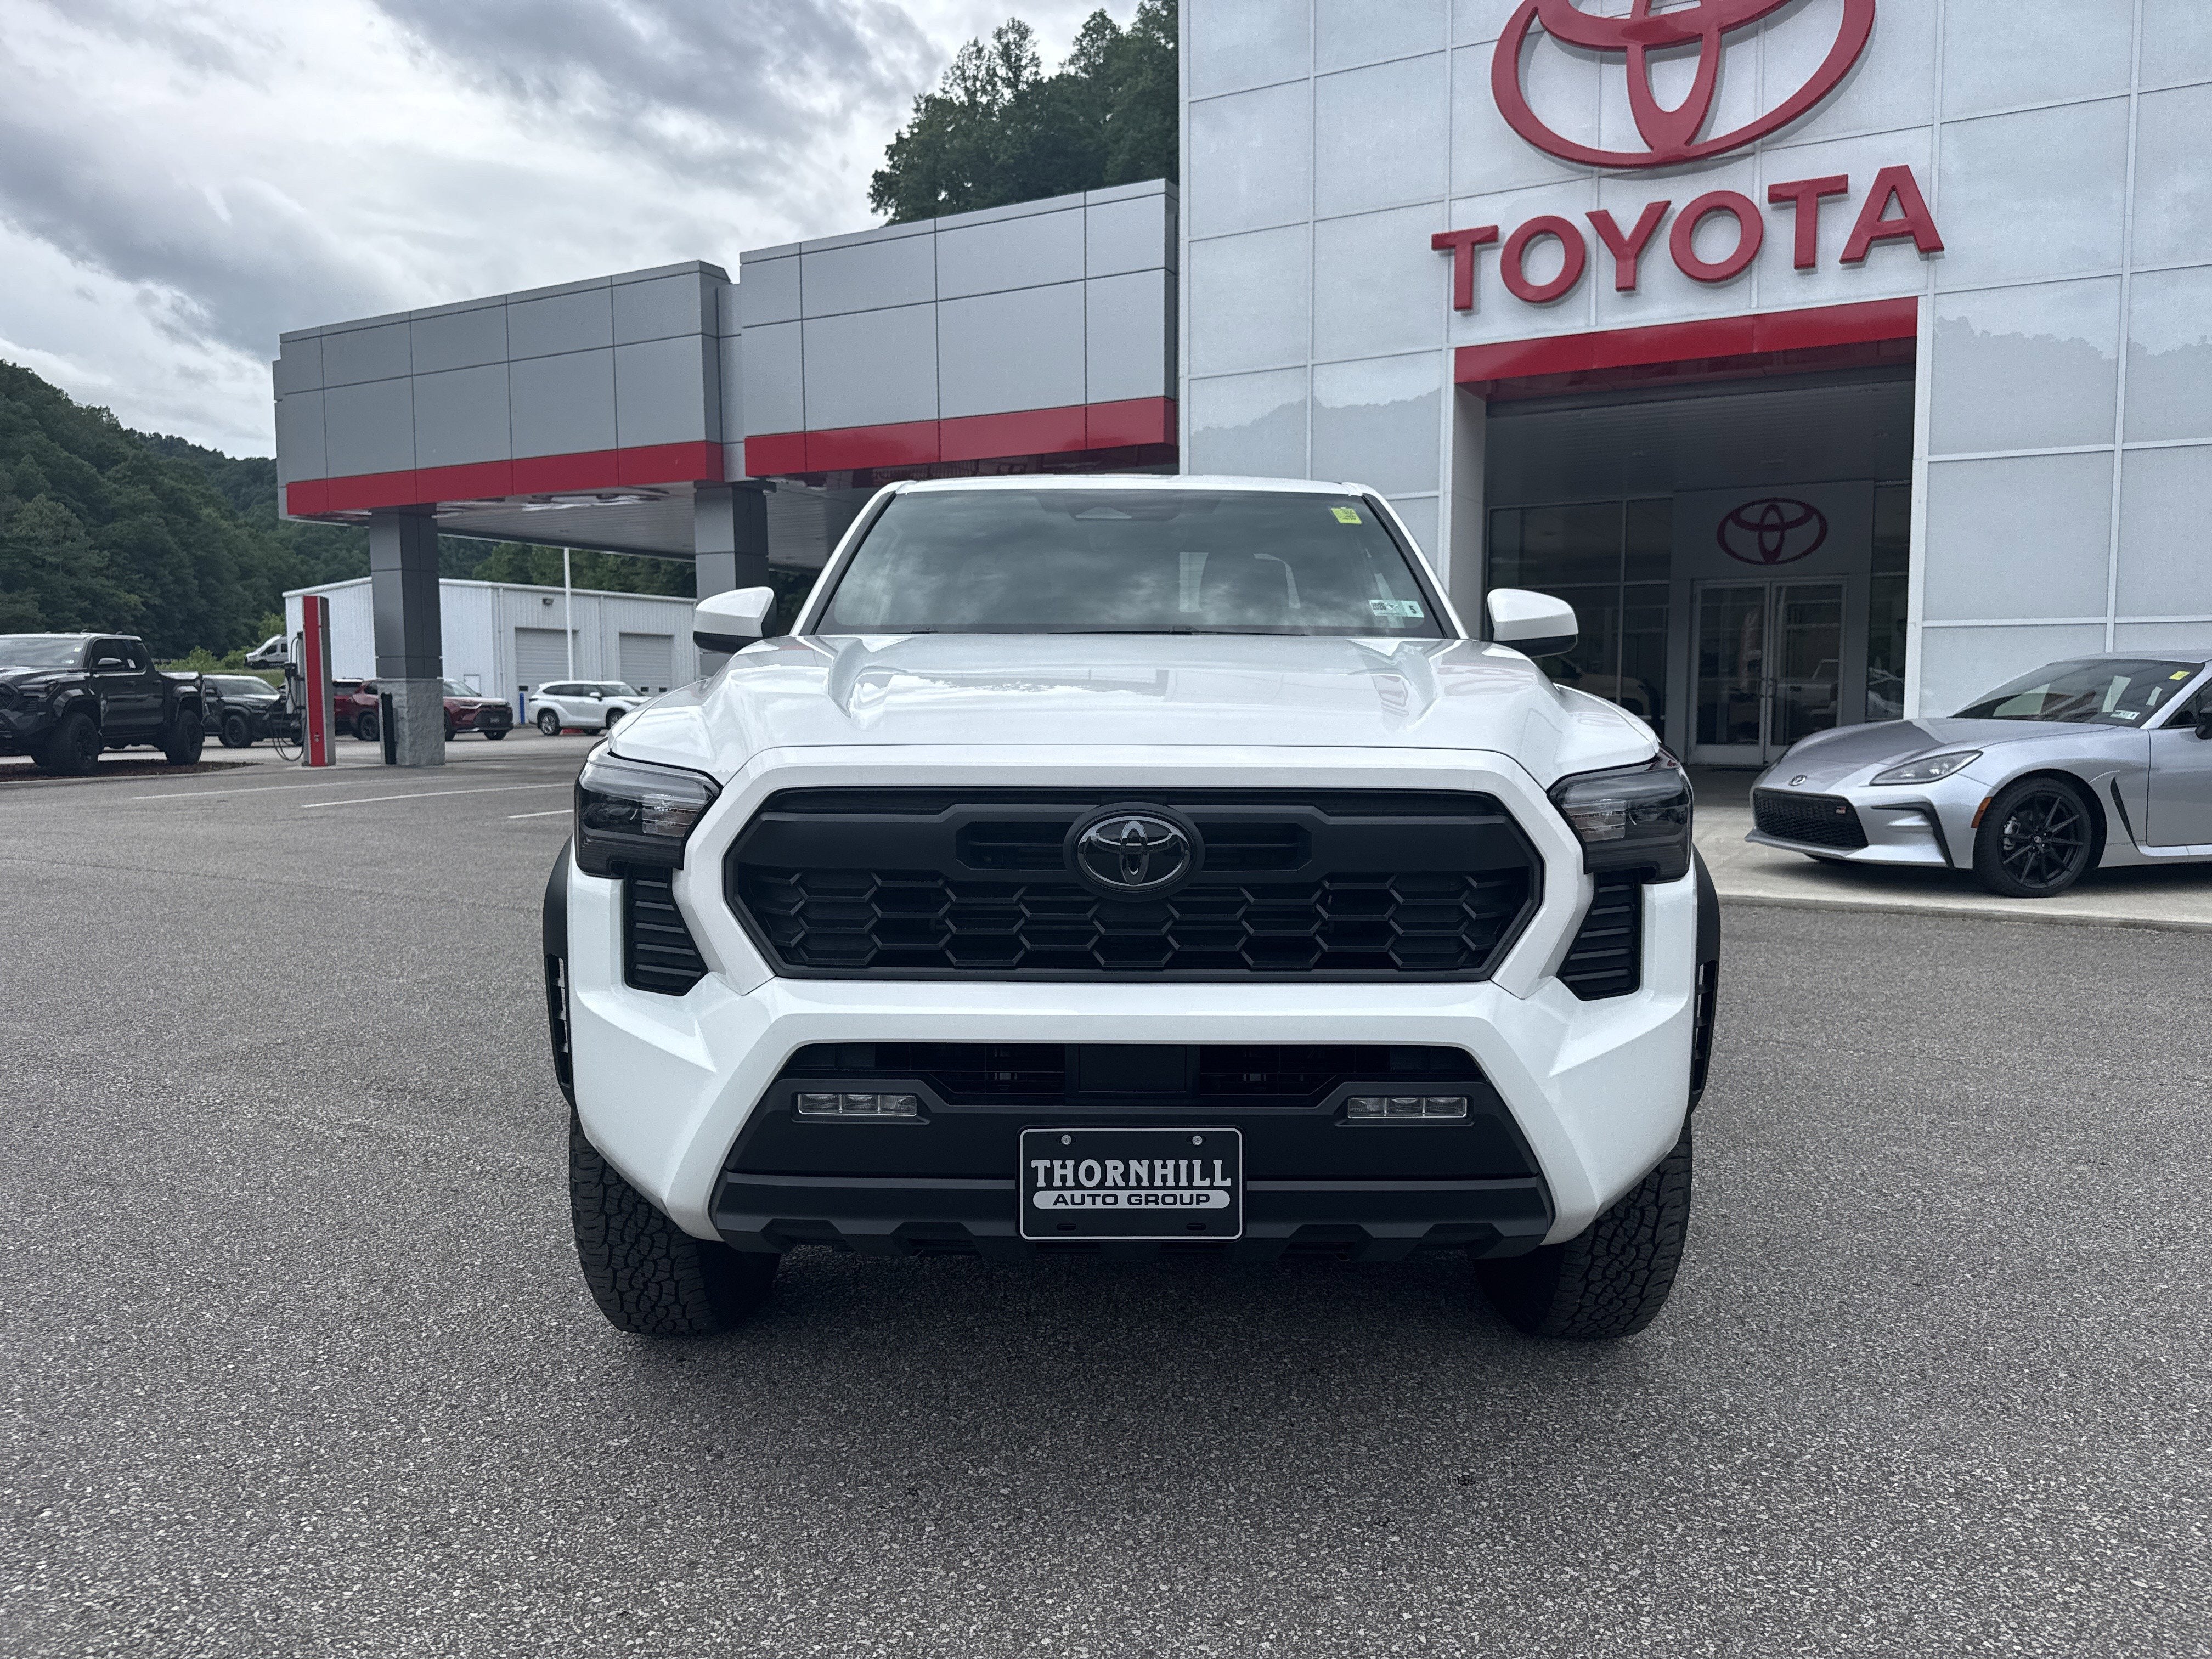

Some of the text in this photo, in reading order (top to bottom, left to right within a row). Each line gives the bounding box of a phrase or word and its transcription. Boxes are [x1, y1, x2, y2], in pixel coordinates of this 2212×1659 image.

[1431, 165, 1944, 311] TOYOTA
[1409, 605, 1417, 614] 5
[1031, 1159, 1231, 1187] THORNHILL
[1052, 1193, 1210, 1206] AUTO GROUP
